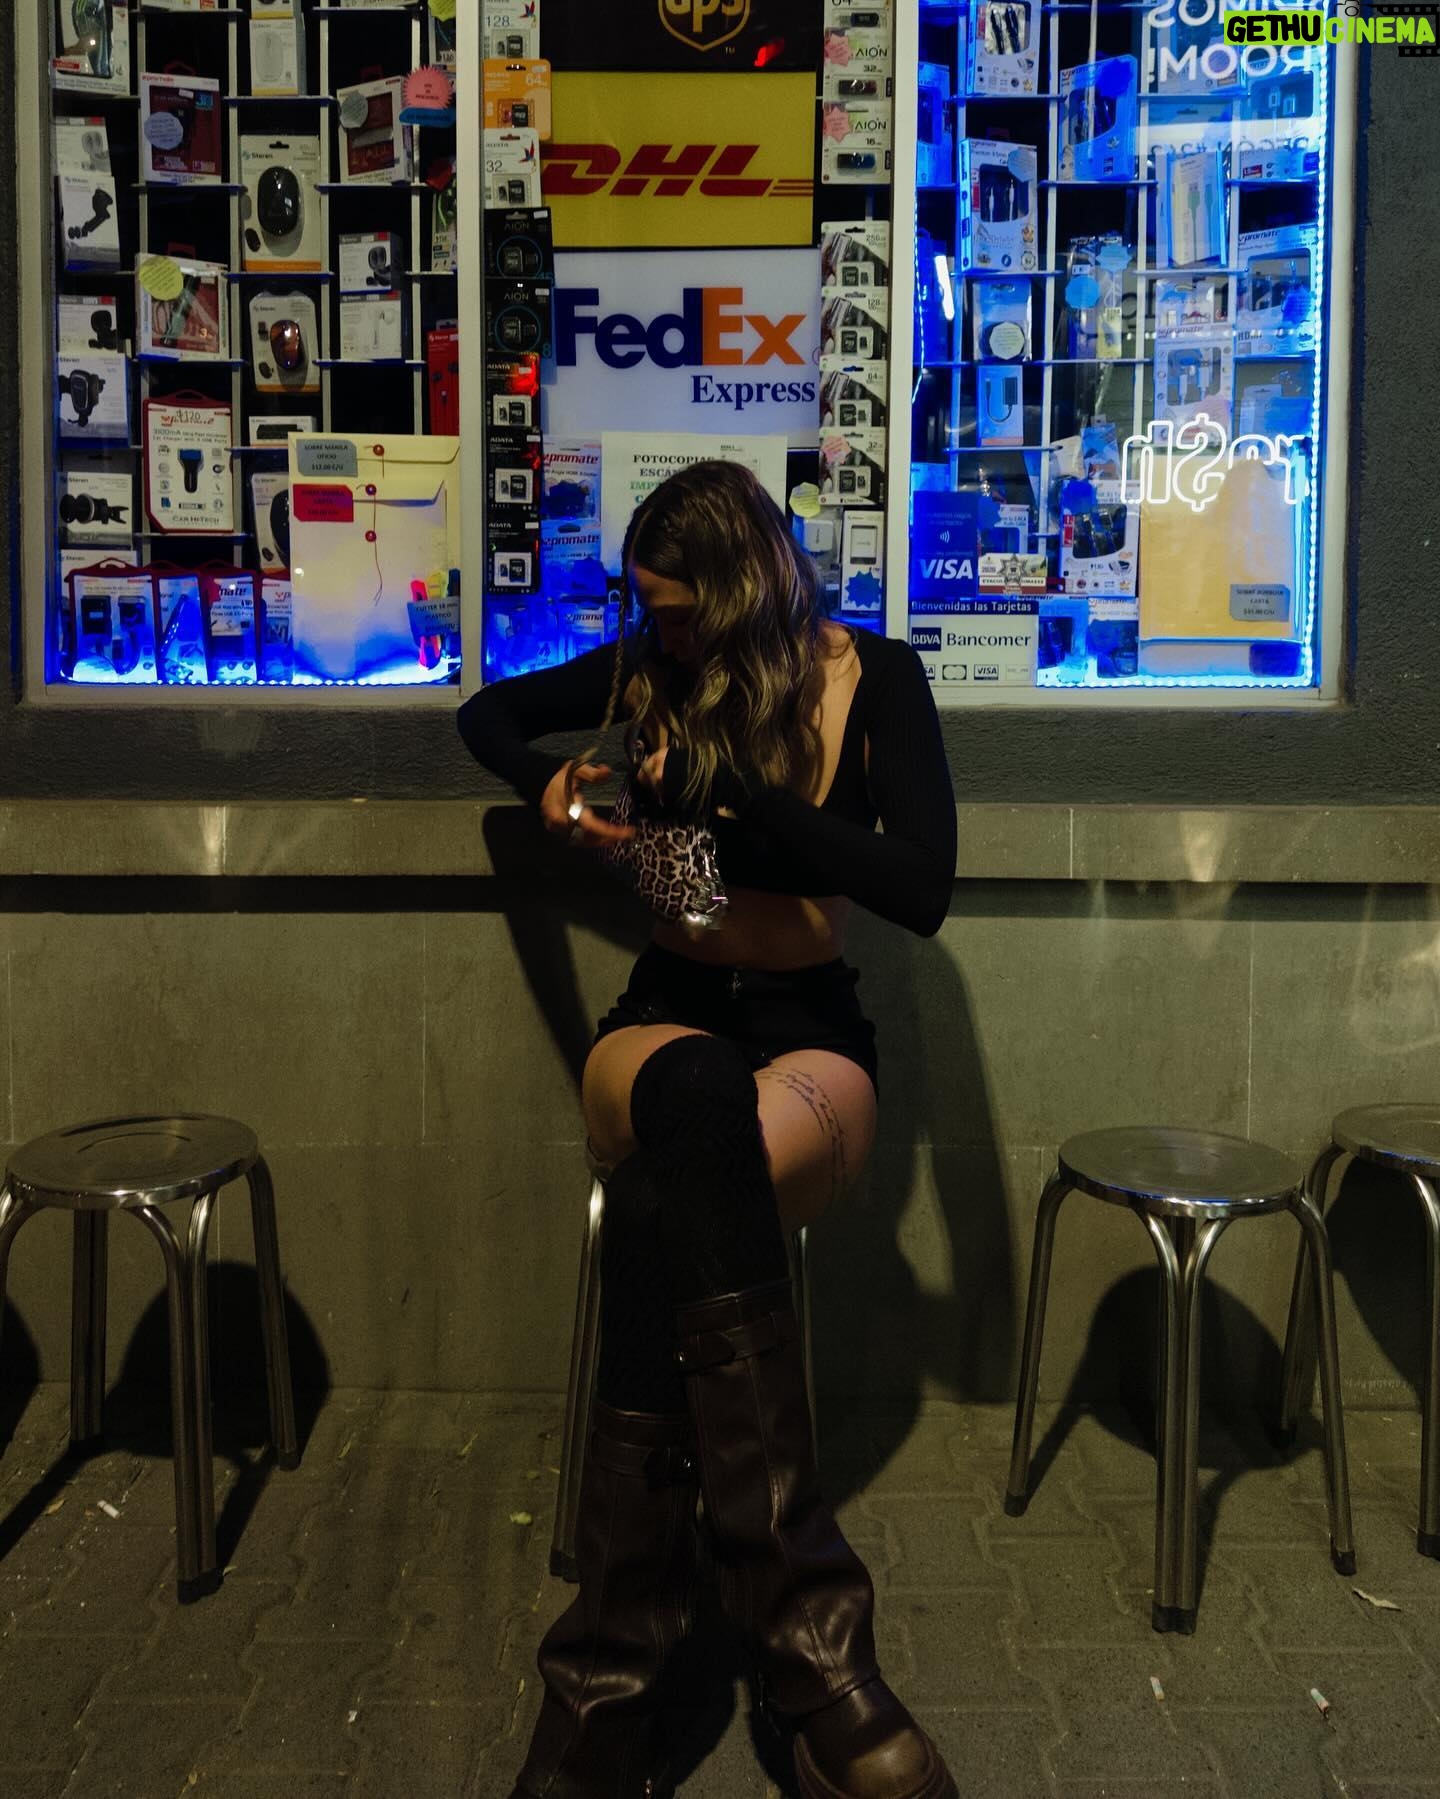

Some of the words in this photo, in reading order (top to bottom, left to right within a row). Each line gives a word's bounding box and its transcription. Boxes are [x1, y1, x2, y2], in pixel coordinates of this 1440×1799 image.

[487, 15, 511, 28] 128
[485, 160, 503, 173] 32
[539, 143, 773, 197] DHL
[553, 286, 808, 369] FedEx
[691, 374, 817, 411] Express
[920, 559, 974, 579] VISA
[911, 600, 971, 612] Bienvenidas
[974, 599, 988, 612] las
[991, 600, 1032, 614] Tarjetas
[912, 633, 941, 645] BBVA
[946, 632, 1032, 647] Bancomer
[977, 666, 998, 675] VISA
